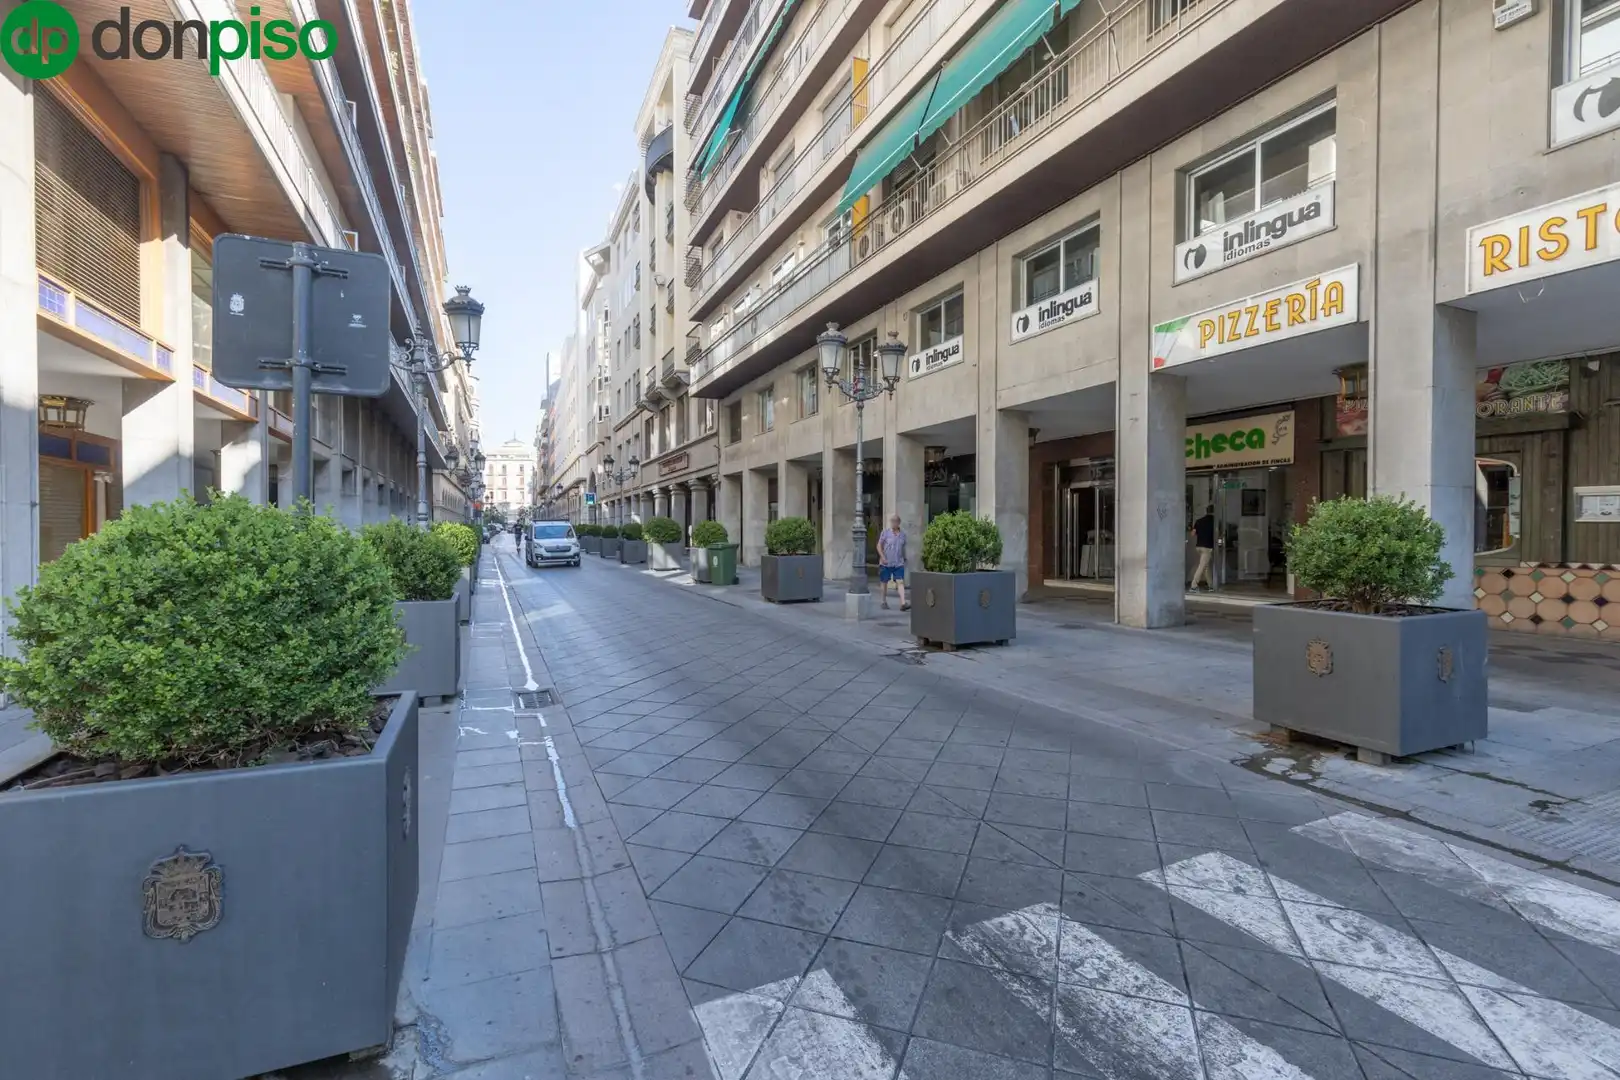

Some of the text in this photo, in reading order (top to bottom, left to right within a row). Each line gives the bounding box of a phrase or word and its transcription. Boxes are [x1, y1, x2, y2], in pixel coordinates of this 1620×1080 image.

[1223, 200, 1321, 252] inlingua
[1478, 202, 1620, 277] RIST
[1223, 237, 1271, 262] idiomas
[1038, 291, 1092, 323] inlingua
[1038, 315, 1066, 330] idiomas
[1197, 277, 1344, 349] PIZZERÍA
[925, 344, 960, 366] inlingua
